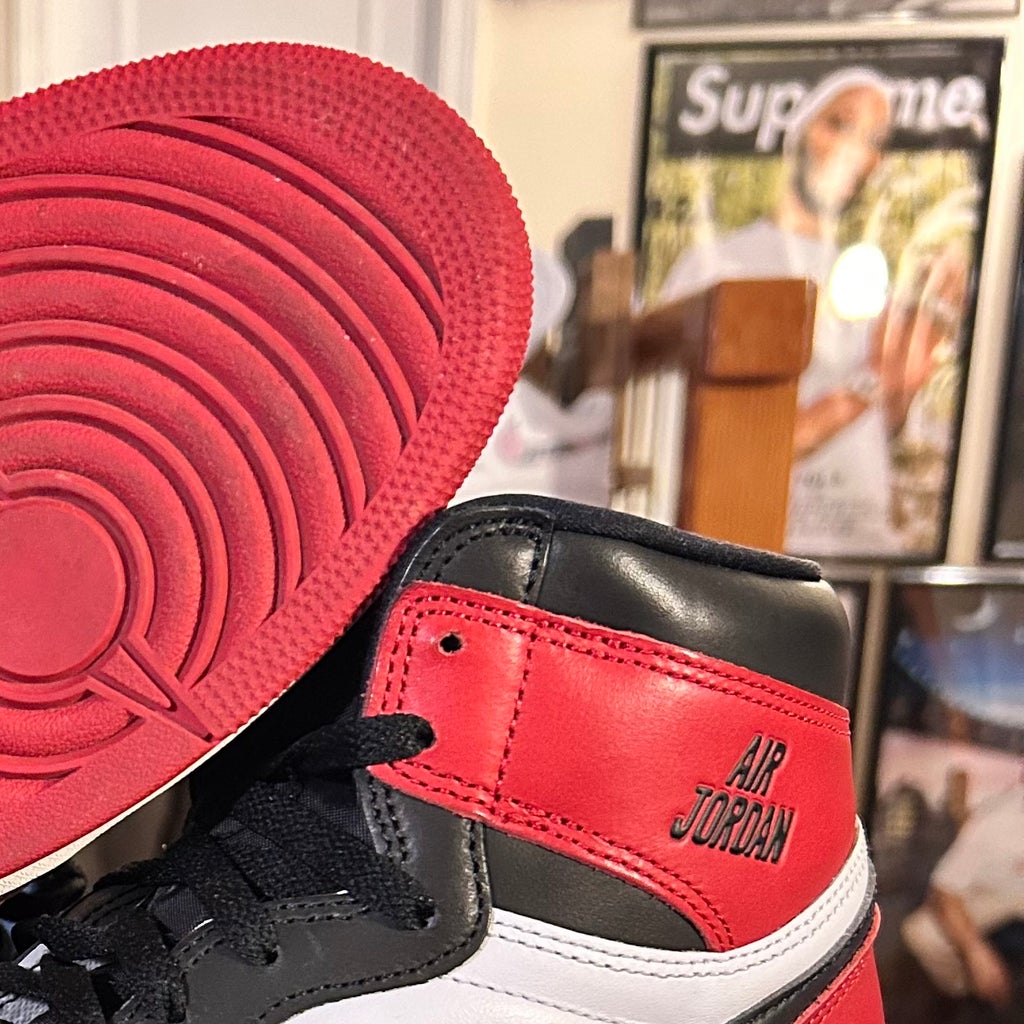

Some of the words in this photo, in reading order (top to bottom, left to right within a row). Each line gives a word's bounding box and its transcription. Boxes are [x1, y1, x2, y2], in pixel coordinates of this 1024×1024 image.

[678, 63, 986, 152] Supme
[725, 734, 787, 797] AIR
[670, 785, 795, 864] JORDAN
